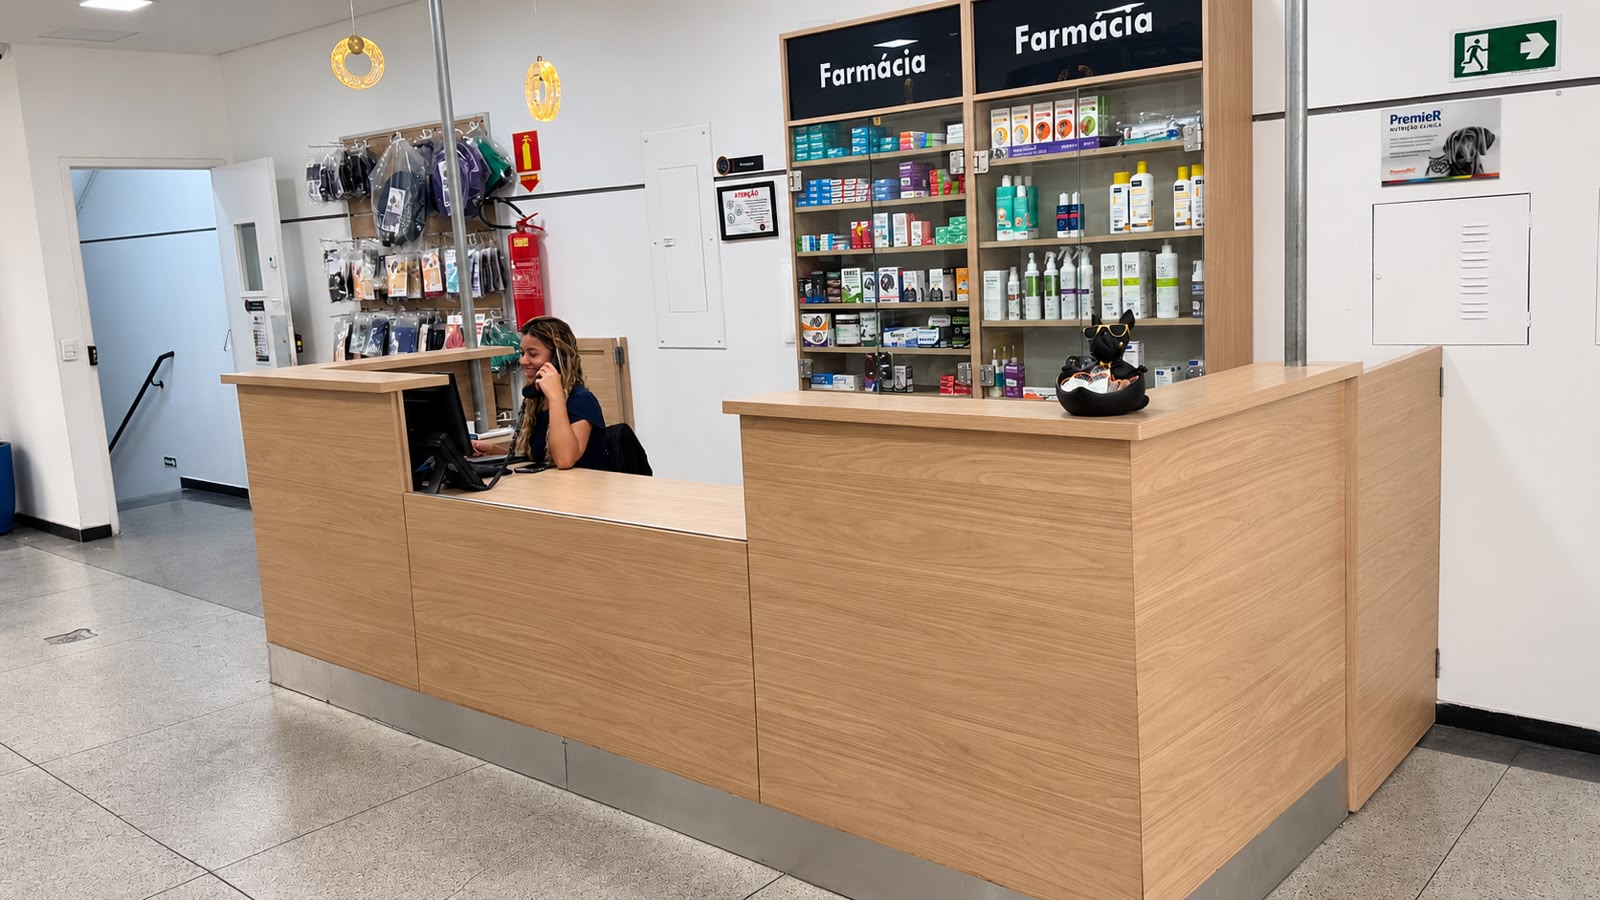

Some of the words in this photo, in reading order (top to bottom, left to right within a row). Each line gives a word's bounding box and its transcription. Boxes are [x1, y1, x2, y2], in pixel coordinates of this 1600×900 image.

[1015, 6, 1153, 55] Farmácia
[820, 49, 926, 88] Farmácia
[1390, 110, 1441, 125] PremieR
[1390, 124, 1418, 132] NUTRIÇÃO
[734, 189, 759, 199] ATENÇÃO
